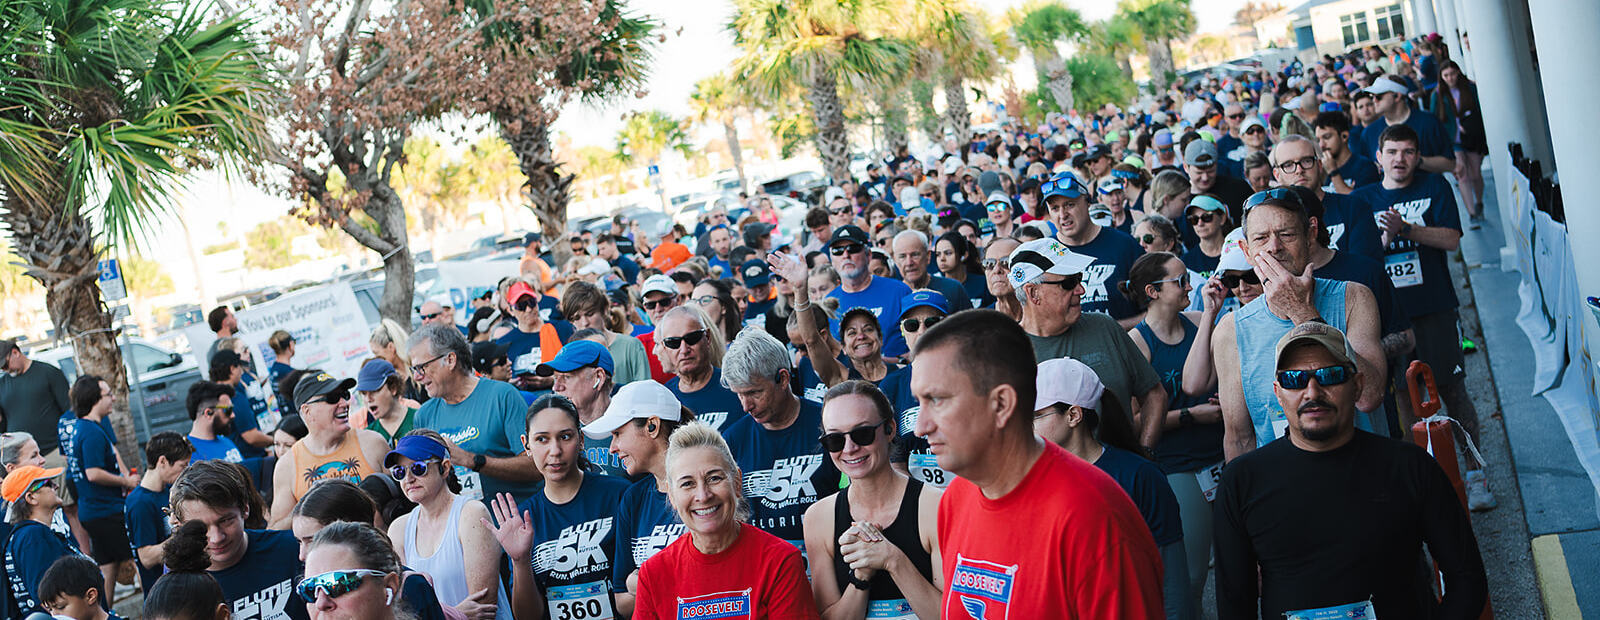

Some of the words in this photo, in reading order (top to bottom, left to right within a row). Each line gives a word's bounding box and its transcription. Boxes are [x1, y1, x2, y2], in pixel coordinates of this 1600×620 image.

[773, 454, 823, 469] FLUTIE
[766, 461, 822, 501] 5K
[922, 468, 945, 485] 98
[559, 516, 613, 539] FLUTIE
[651, 523, 686, 537] FLUT
[752, 515, 805, 530] FLORI
[552, 527, 612, 572] 5K
[549, 570, 570, 580] RUN.
[591, 561, 610, 573] ROLL
[954, 569, 1006, 595] ROOSEVELT
[233, 578, 292, 614] FLUTIE
[557, 598, 602, 620] 360
[683, 600, 744, 619] ROOSEVELT
